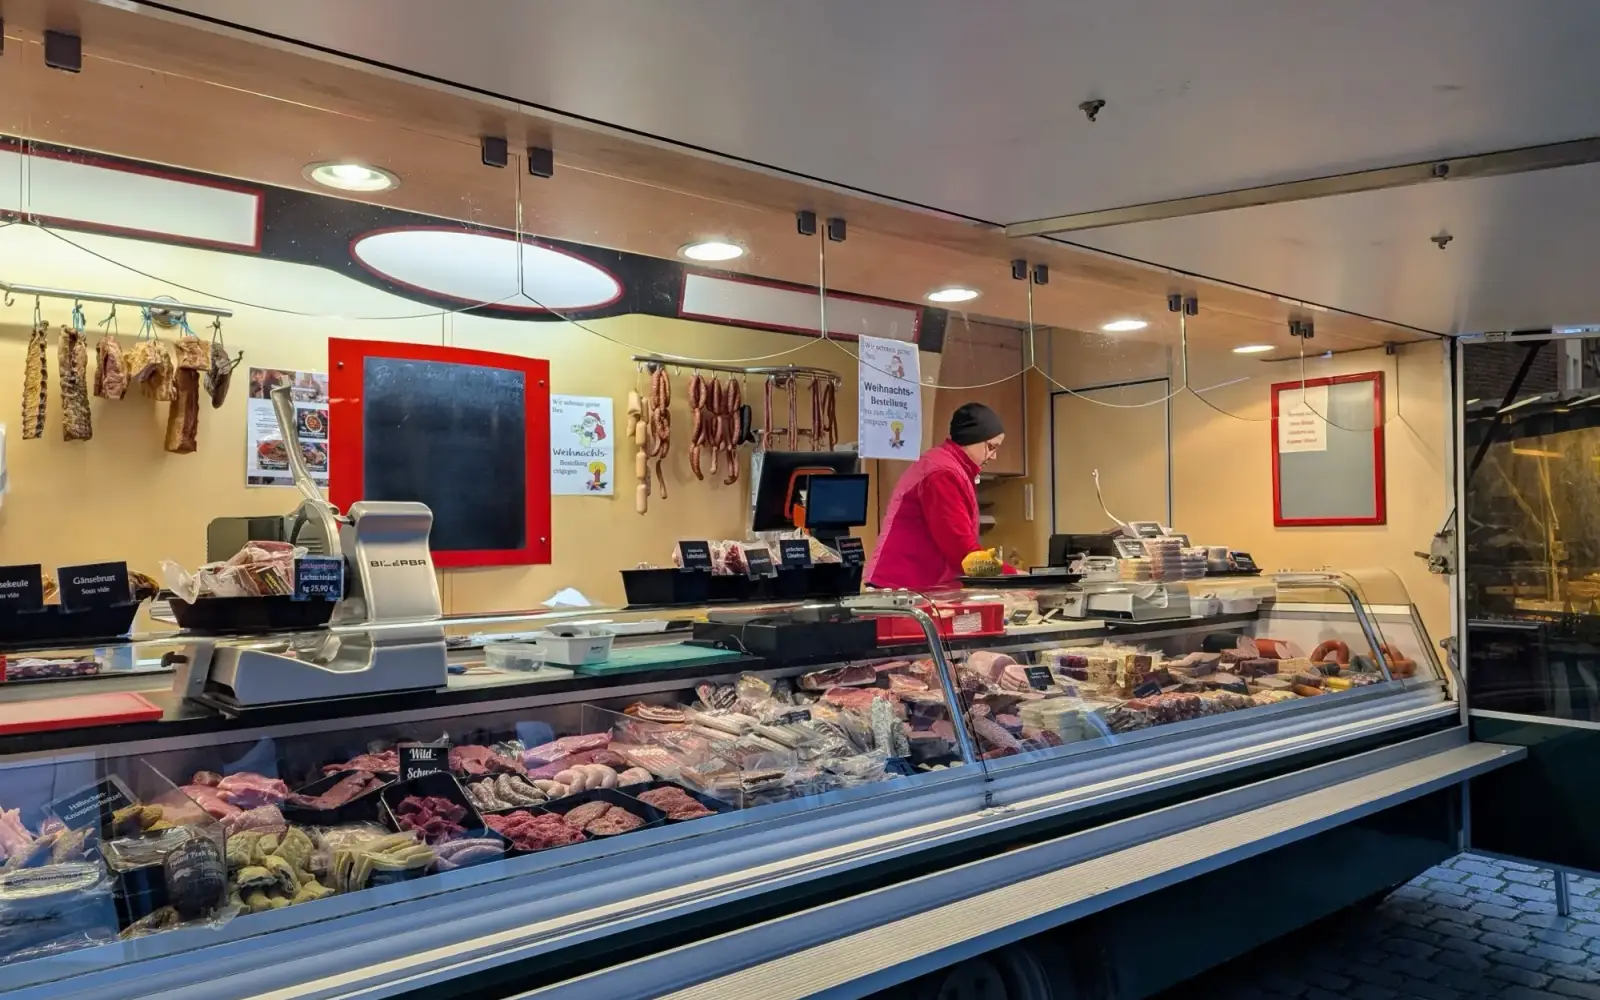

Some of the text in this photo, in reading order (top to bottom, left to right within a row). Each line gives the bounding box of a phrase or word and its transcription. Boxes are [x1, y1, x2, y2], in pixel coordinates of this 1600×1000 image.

[864, 381, 914, 396] Weihnachts-
[870, 395, 908, 410] Bestellung
[553, 448, 608, 457] Weihnachts-
[73, 574, 116, 585] Gänsebrust
[302, 584, 309, 593] kg
[310, 584, 329, 592] 25,90
[409, 748, 432, 759] Wild
[63, 792, 123, 822] Knusperschnitzel
[68, 791, 107, 812] Hähnchen-
